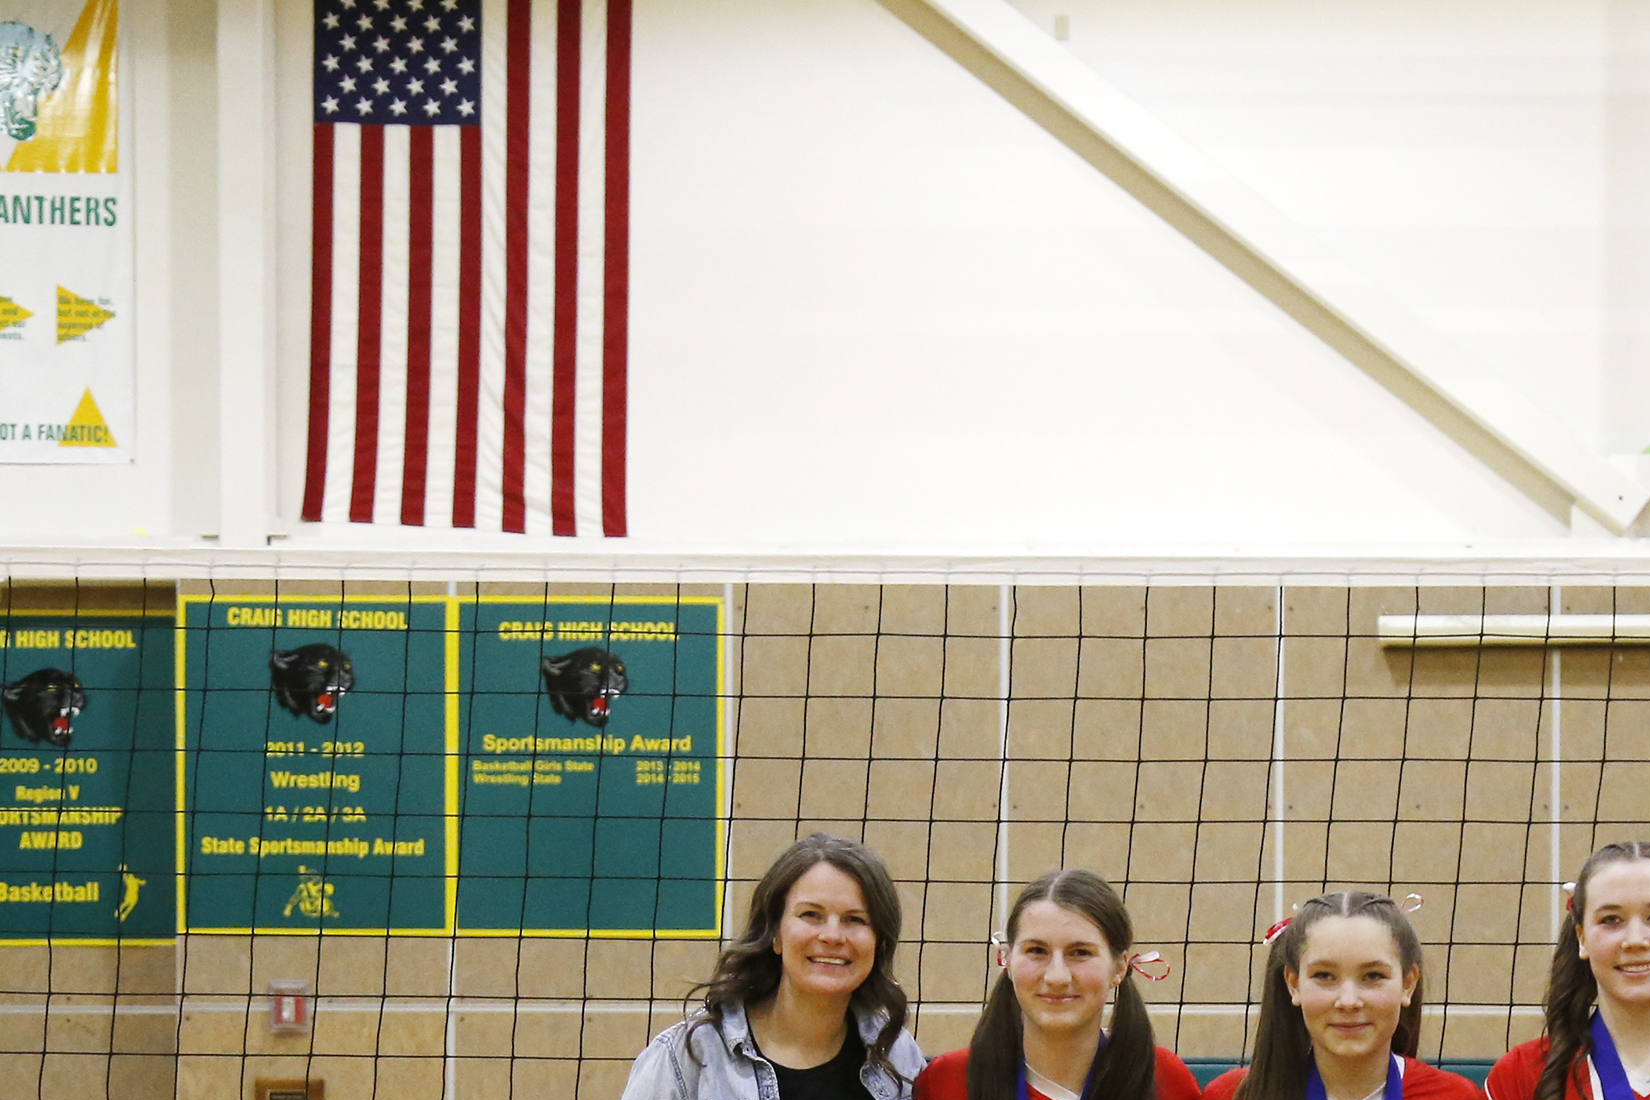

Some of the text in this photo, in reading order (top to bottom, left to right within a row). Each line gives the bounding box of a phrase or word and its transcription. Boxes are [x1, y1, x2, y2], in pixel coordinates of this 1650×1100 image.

[22, 423, 32, 441] A
[39, 423, 110, 443] FANATIC!
[226, 606, 410, 631] CRAIG HIGH SCHOOL
[16, 630, 60, 648] HIGH
[65, 630, 137, 648] SCHOOL
[498, 621, 680, 642] CRAIG HIGH SCHOOL
[264, 741, 305, 758] 2011
[321, 741, 366, 759] 2012
[482, 733, 693, 755] Sportsmanship Award
[0, 758, 40, 775] 2009
[54, 758, 98, 775] 2010
[564, 760, 595, 772] State
[271, 771, 361, 793] Wrestling
[473, 773, 530, 786] Wrestling
[15, 785, 80, 804] Region V
[265, 806, 289, 823] 1A
[302, 806, 329, 823] 2A
[342, 806, 367, 823] 3A
[19, 831, 83, 849] AWARD
[201, 836, 425, 858] State Sportsmanship Award
[0, 881, 99, 903] Basketball
